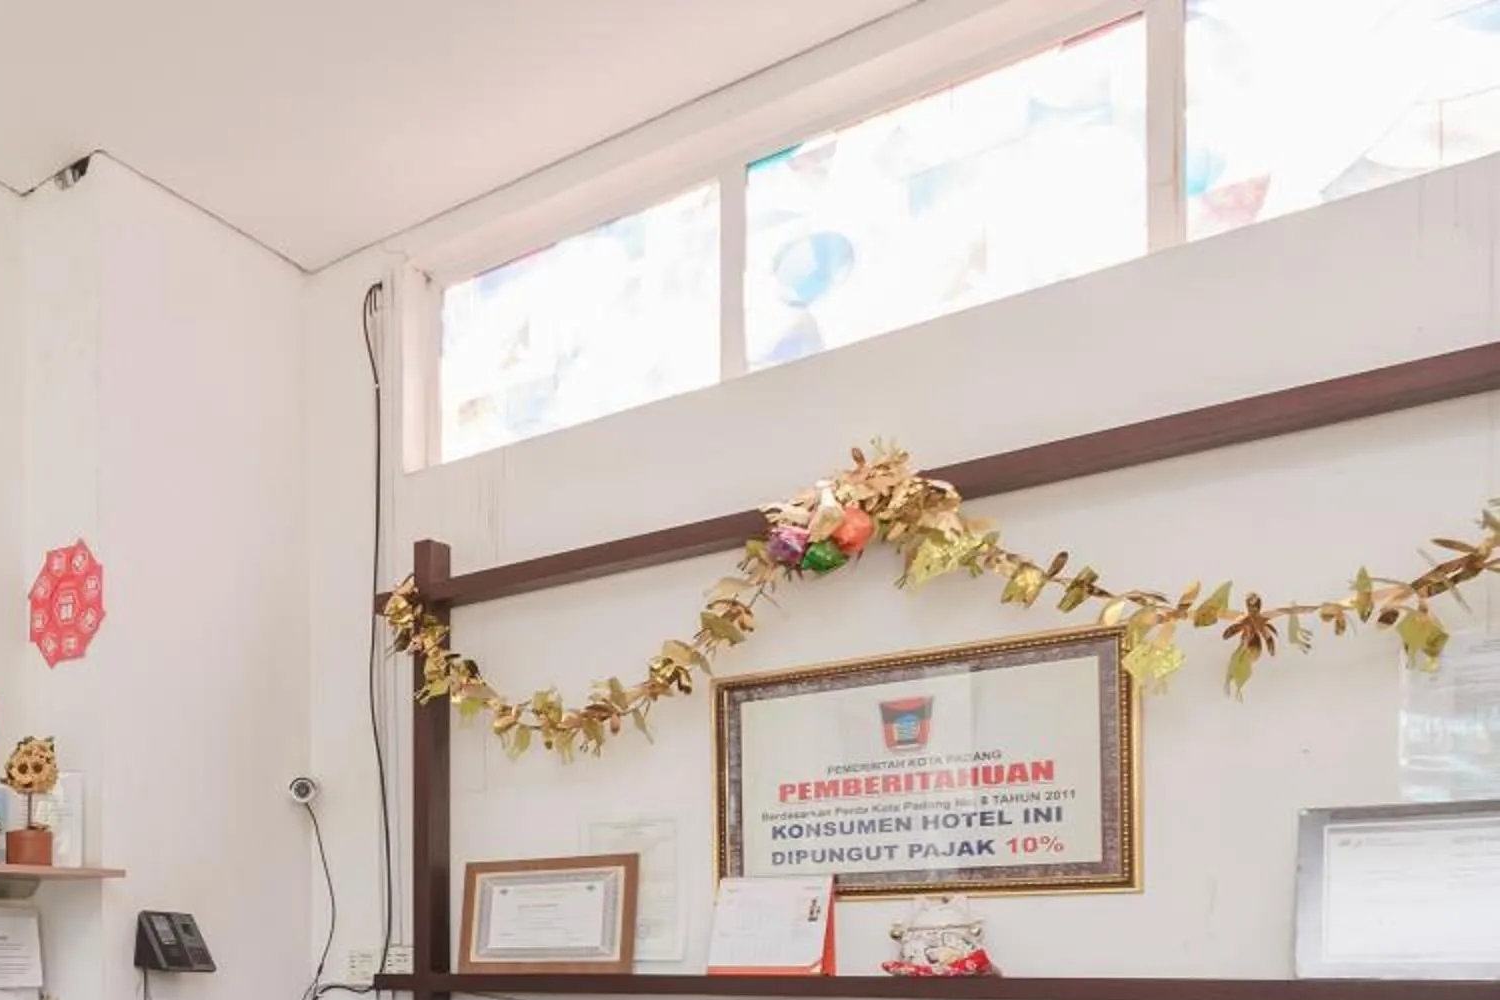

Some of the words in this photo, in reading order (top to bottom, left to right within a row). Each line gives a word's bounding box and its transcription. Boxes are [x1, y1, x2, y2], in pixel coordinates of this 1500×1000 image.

[779, 760, 1055, 803] PEMBERITAHUAN
[993, 791, 1041, 805] TAHUN
[1045, 789, 1076, 801] 2011
[771, 816, 912, 840] KONSUMEN
[922, 810, 1013, 831] HOTEL
[1023, 806, 1063, 824] INI
[771, 845, 899, 866] DIPUNGUT
[908, 839, 996, 859] PAJAK
[1005, 835, 1065, 854] 10%
